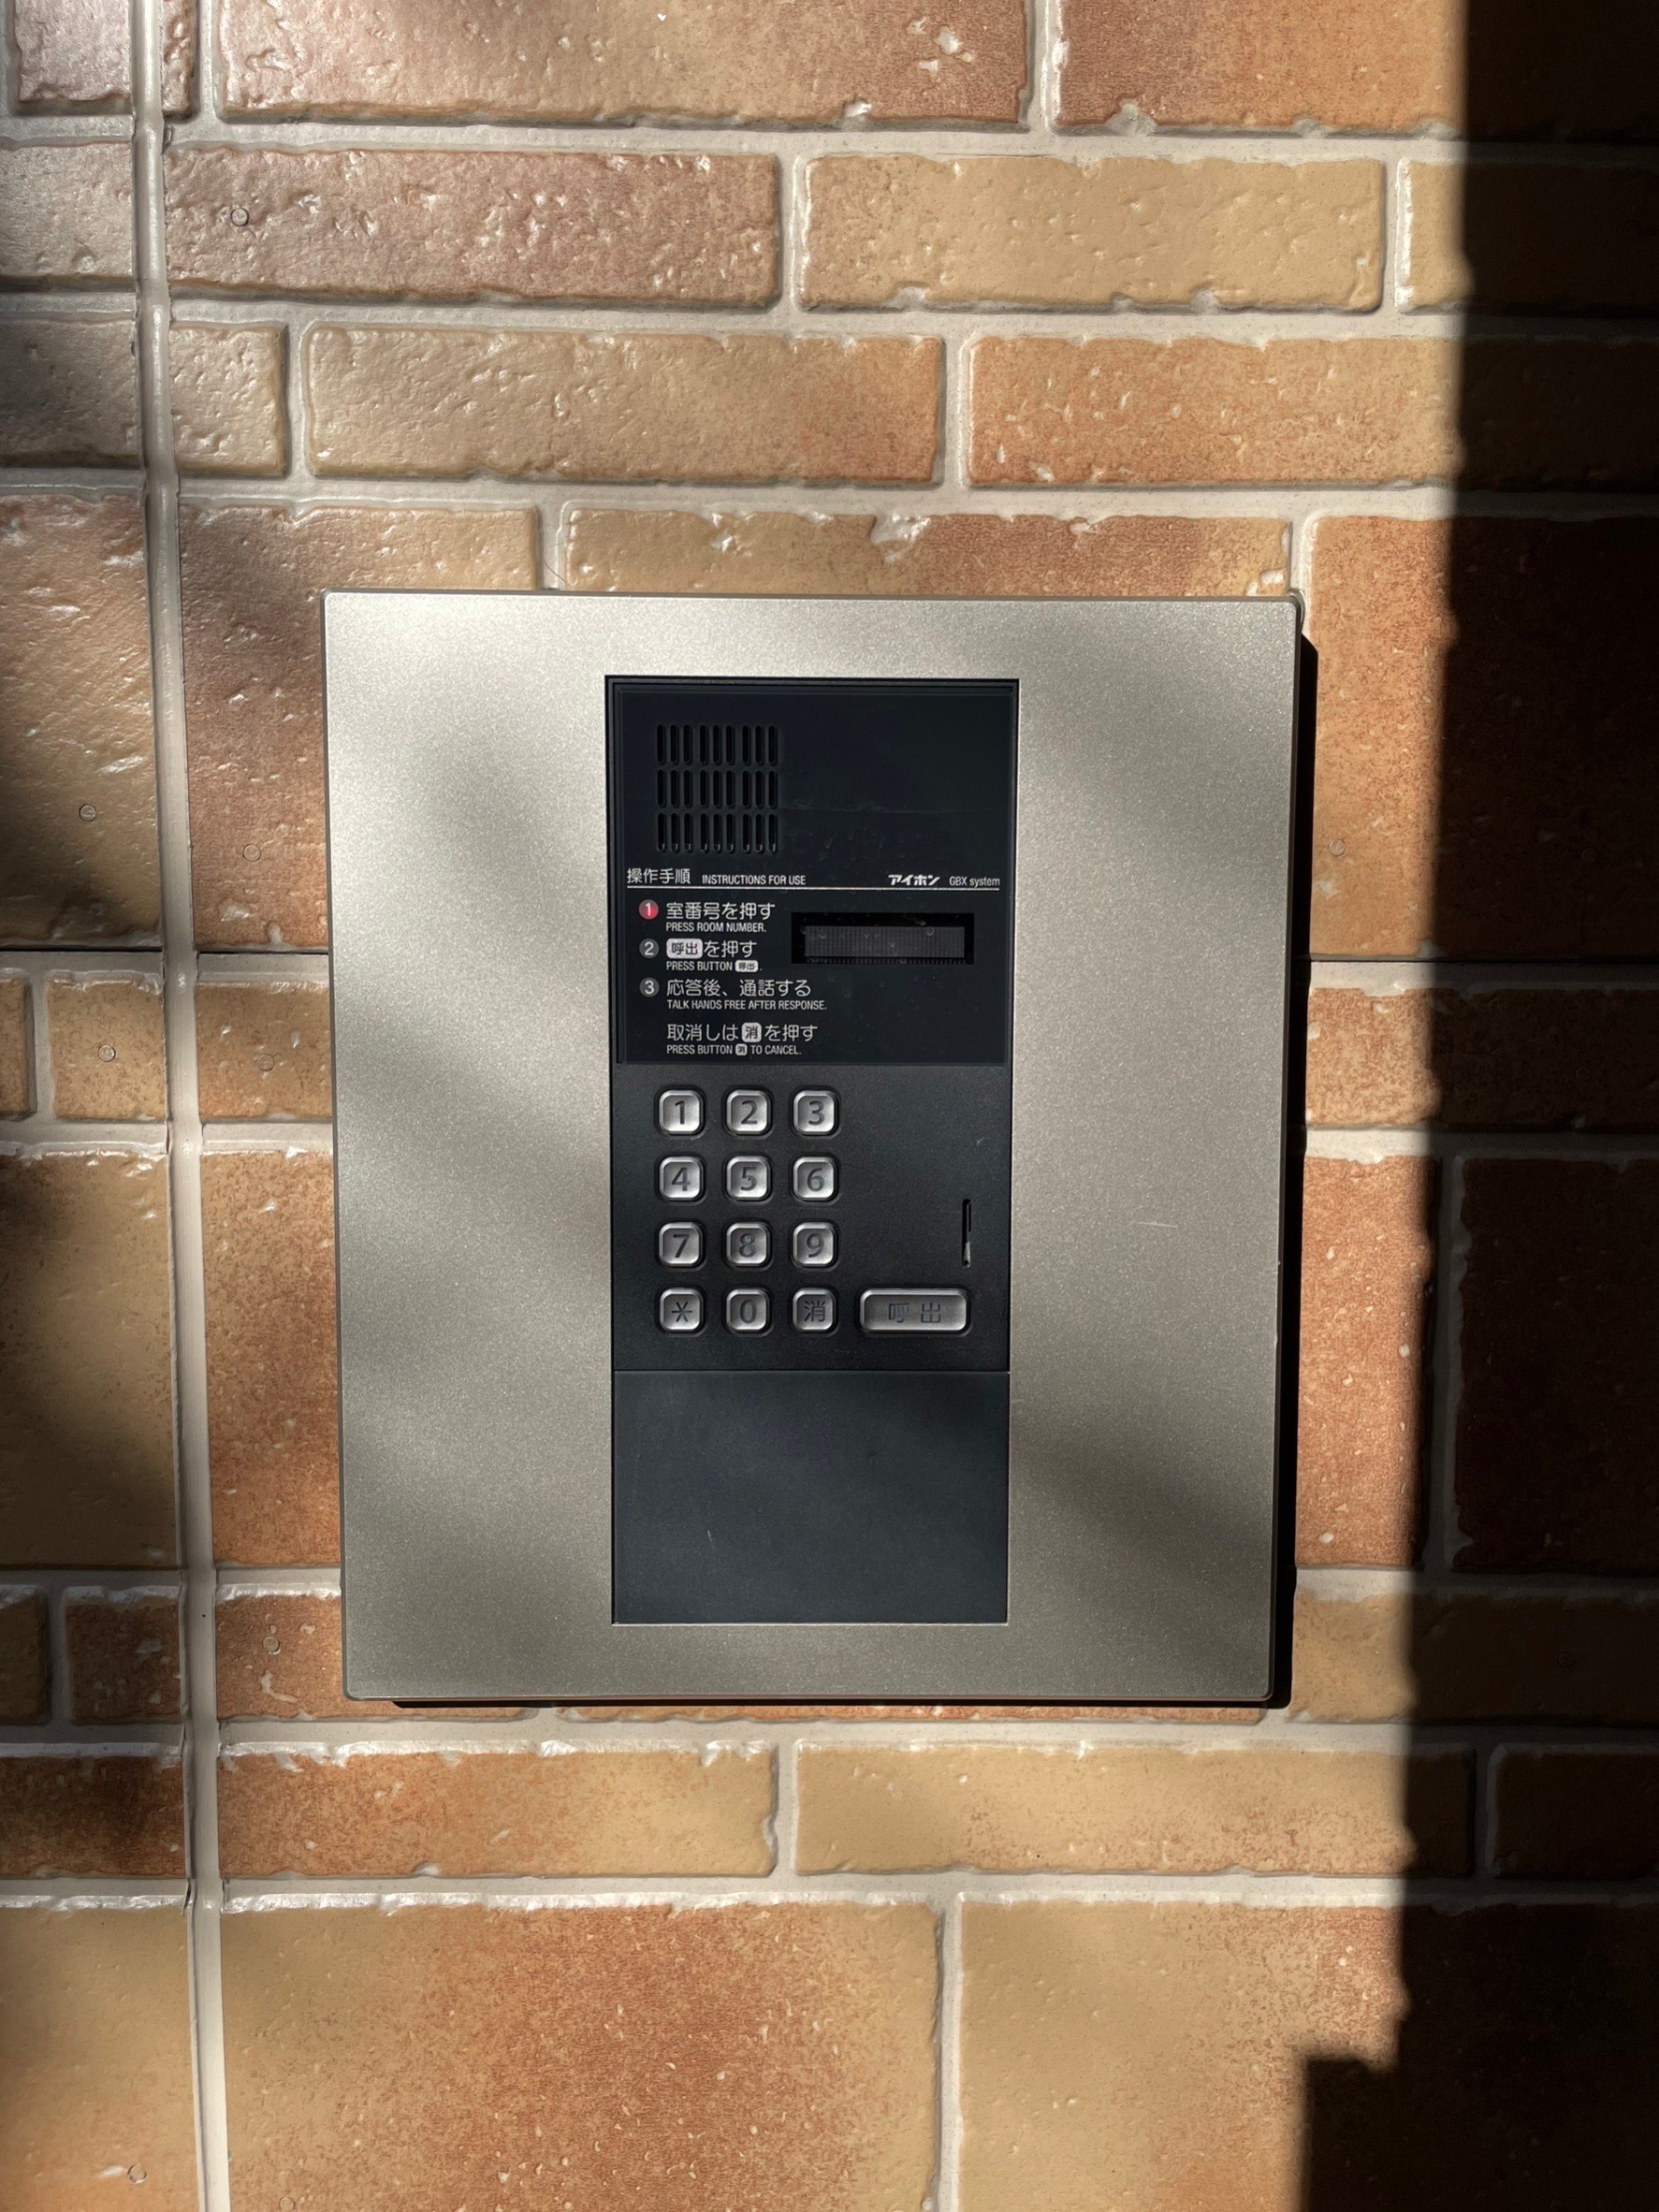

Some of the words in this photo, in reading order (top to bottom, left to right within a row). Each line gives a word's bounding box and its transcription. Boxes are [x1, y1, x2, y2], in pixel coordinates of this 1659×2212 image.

[627, 867, 691, 884] 操作手順
[702, 874, 766, 885] INSTRUCTIONS
[768, 875, 787, 885] FOR
[788, 875, 807, 885] USE
[888, 874, 940, 886] アイホン
[949, 876, 968, 886] GBX
[968, 876, 1000, 888] system
[665, 902, 776, 920] 室番号を押す
[665, 922, 695, 932] PRESS
[696, 922, 724, 932] ROOM
[725, 922, 767, 933] NUMBER.
[665, 961, 695, 971] PRESS
[696, 961, 733, 971] BUTTON
[666, 979, 811, 997] 応答後、通話する
[666, 999, 690, 1010] TALK
[691, 999, 722, 1010] HANDS
[724, 999, 746, 1010] FREE
[748, 999, 777, 1010] AFTER
[778, 1000, 827, 1011] RESPONSE.
[666, 1044, 695, 1055] PRESS
[697, 1044, 733, 1055] BUTTON
[750, 1044, 763, 1055] TO
[764, 1044, 802, 1055] CANCEL.
[675, 1100, 685, 1125] 1
[740, 1100, 758, 1125] 2
[808, 1100, 825, 1126] 3
[671, 1167, 691, 1192] 4
[740, 1166, 757, 1191] 5
[807, 1167, 825, 1192] 6
[673, 1233, 691, 1259] 7
[738, 1233, 757, 1258] 8
[807, 1233, 825, 1258] 9
[739, 1299, 757, 1324] 0
[804, 1300, 825, 1322] 消
[889, 1302, 941, 1323] 呼出
